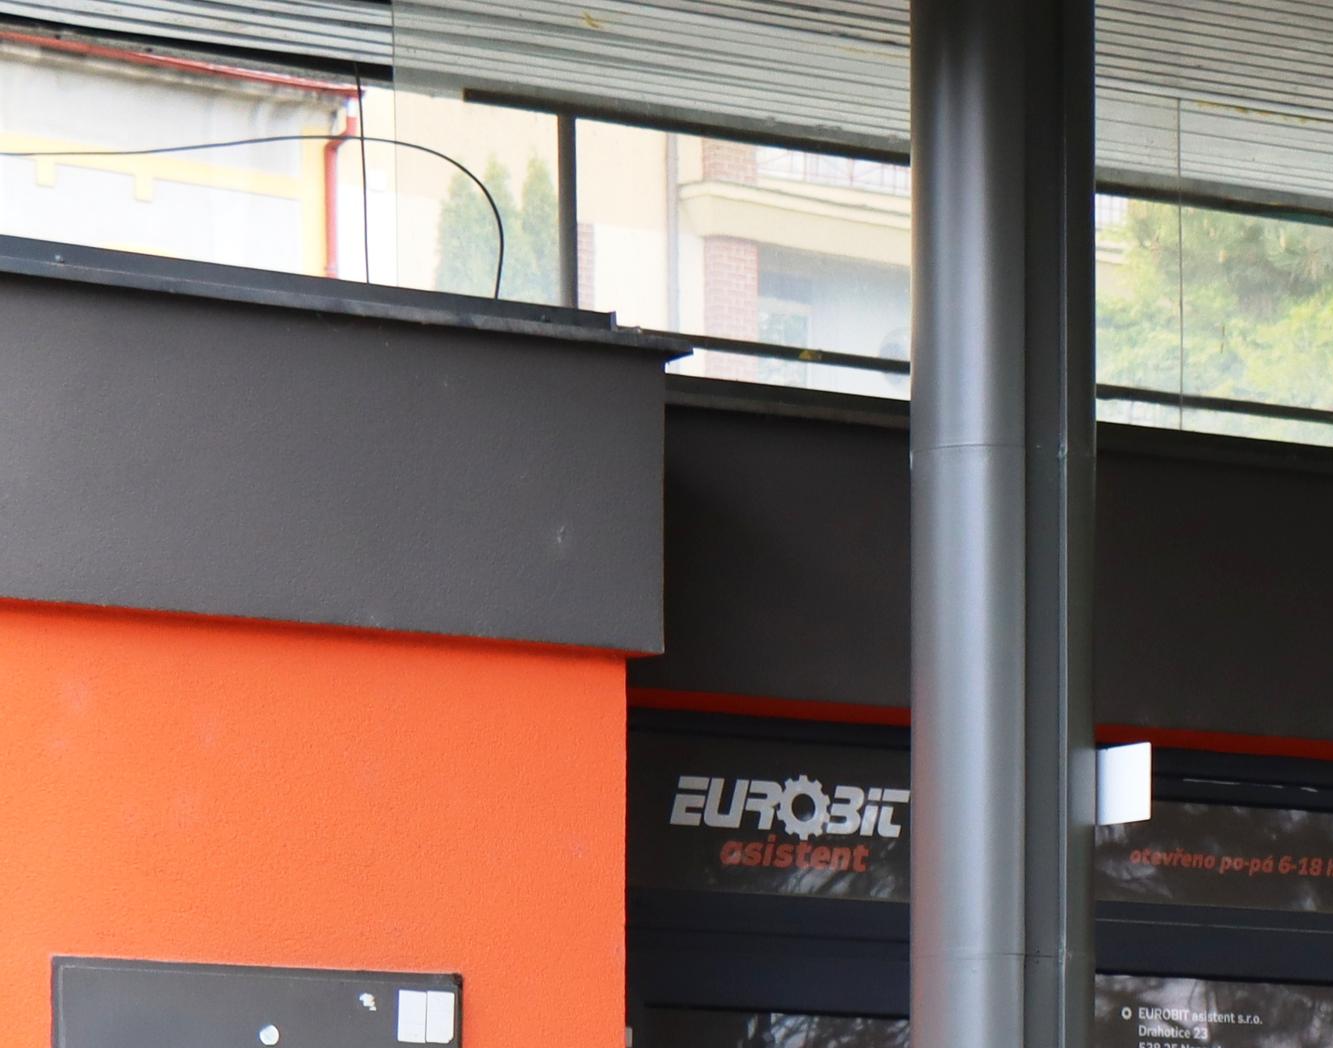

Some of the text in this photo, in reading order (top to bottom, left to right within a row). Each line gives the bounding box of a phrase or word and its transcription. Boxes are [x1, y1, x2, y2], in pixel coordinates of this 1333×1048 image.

[720, 835, 869, 872] asistent
[1130, 849, 1215, 869] otevřeno
[1219, 855, 1273, 876] po-pá
[1278, 856, 1322, 876] 6-18
[1138, 1008, 1263, 1024] EUROBIT asistent s.r.o.
[1193, 1027, 1208, 1039] 23
